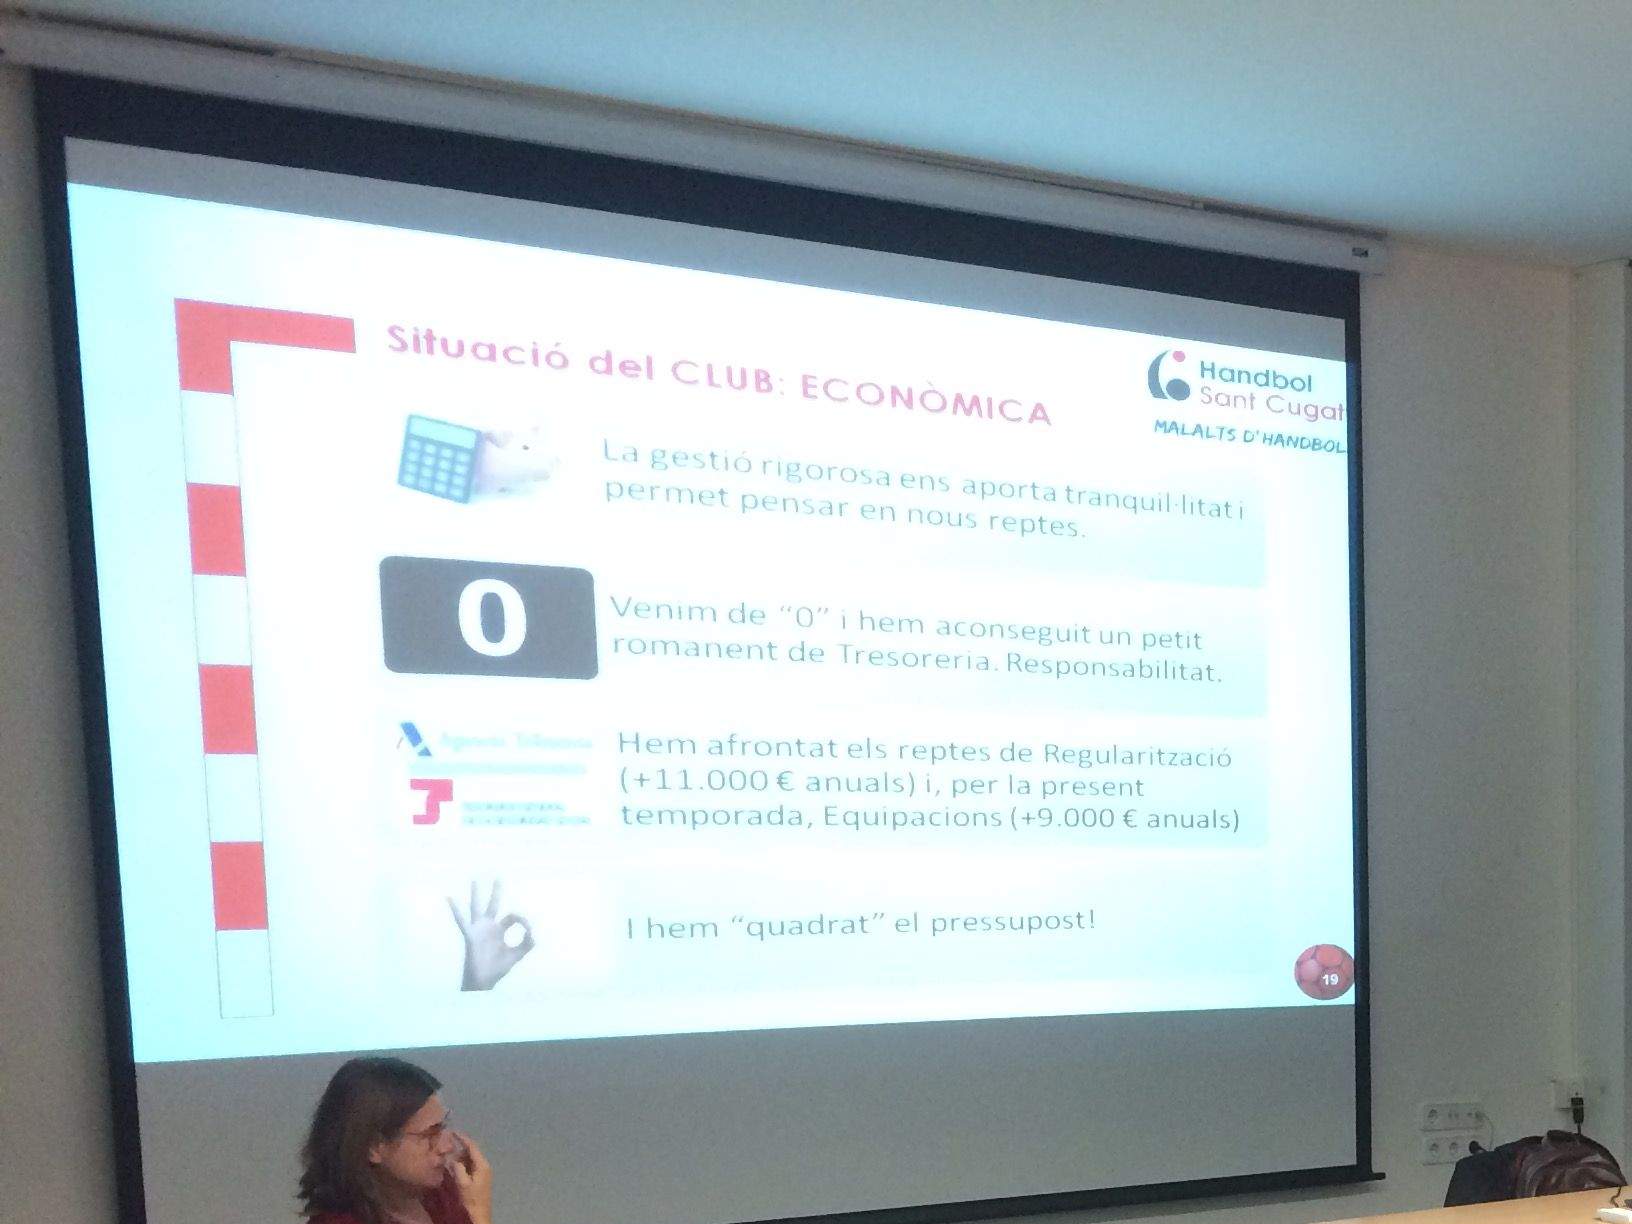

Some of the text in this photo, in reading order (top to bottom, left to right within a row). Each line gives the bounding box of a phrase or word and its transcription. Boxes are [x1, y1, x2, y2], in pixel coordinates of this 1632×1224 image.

[387, 324, 1052, 426] Situació del CLUB: ECONÒMICA
[1200, 361, 1312, 393] Handbol
[1200, 386, 1345, 423] Sant Cugat
[1155, 419, 1346, 454] MALALTS D'HANDBOL
[604, 438, 637, 463] La
[651, 446, 751, 474] gestió
[762, 460, 891, 487] rigorosa
[900, 469, 950, 493] ens
[963, 475, 1056, 506] aporta
[606, 479, 1086, 539] permet pensar en nous reptes.
[458, 578, 527, 657] 0
[610, 596, 717, 623] Venim
[729, 602, 766, 625] de
[860, 610, 924, 635] hem
[936, 618, 1090, 646] aconseguit
[1100, 628, 1131, 646] un
[1142, 631, 1203, 653] petit
[614, 637, 1222, 683] romanent de Tresoreria. Responsabilitat.
[619, 732, 697, 754] Hem
[708, 733, 838, 759] afrontat
[847, 738, 887, 760] els
[899, 742, 991, 765] reptes
[1000, 742, 1033, 764] de
[1045, 743, 1232, 769] Regularització
[619, 768, 1144, 799] (+11.000 € anuals) i, per la present
[622, 805, 1240, 833] temporada, Equipacions (+9.000 € anuals)
[648, 918, 719, 939] hem
[895, 912, 918, 933] el
[932, 909, 1095, 936] pressupost!
[1323, 973, 1339, 986] 19
